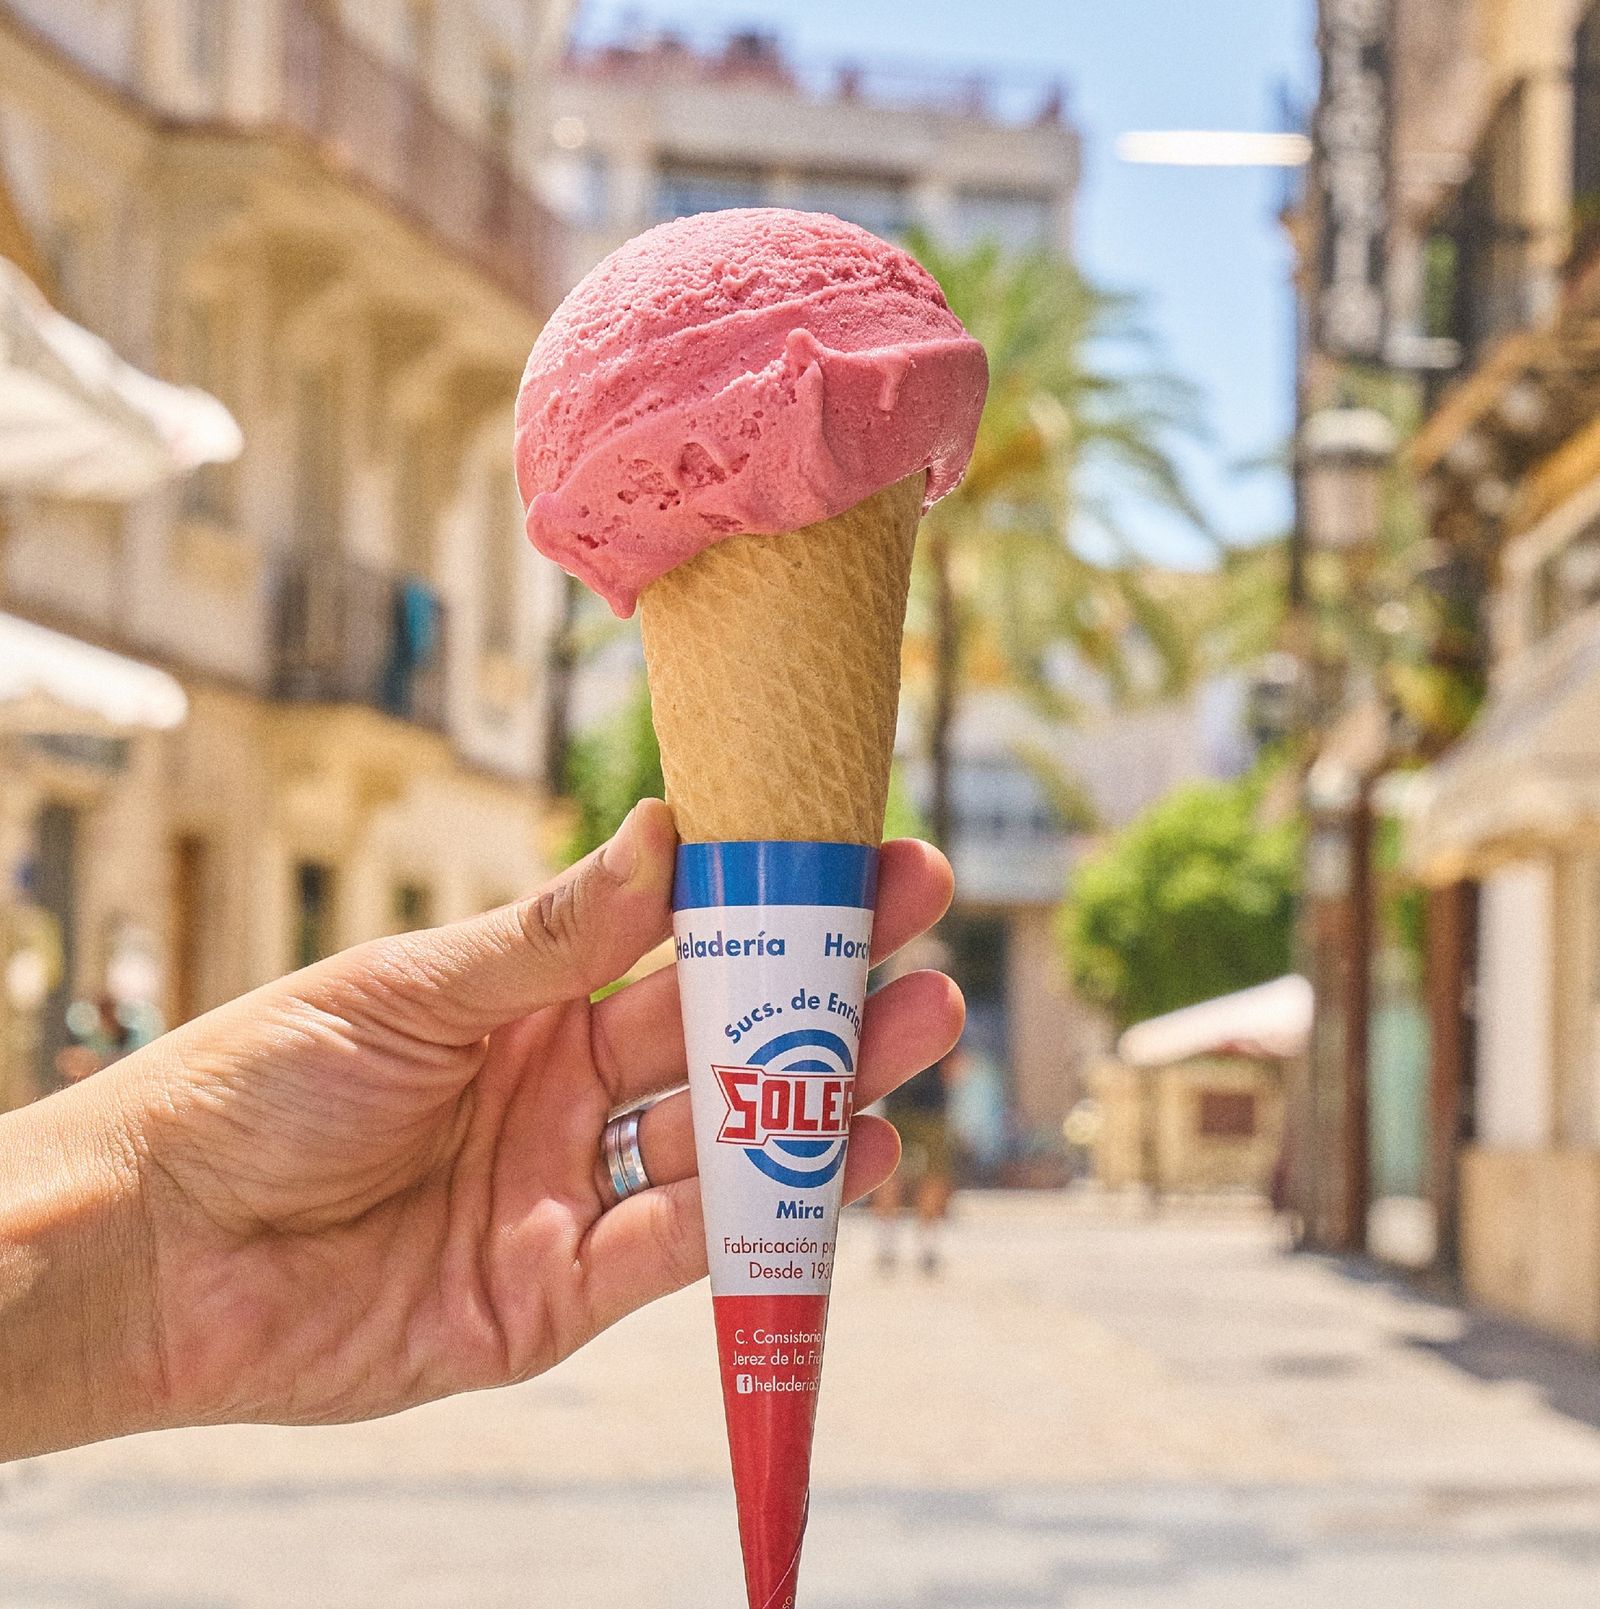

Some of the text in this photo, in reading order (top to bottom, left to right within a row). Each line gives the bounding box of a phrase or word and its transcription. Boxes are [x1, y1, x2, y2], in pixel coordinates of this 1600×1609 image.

[675, 930, 786, 961] Heladería
[724, 1002, 783, 1044] Sucs.
[790, 988, 821, 1011] de
[775, 1200, 824, 1219] Mira
[724, 1235, 818, 1255] Fabricación
[750, 1261, 804, 1280] Desde
[735, 1329, 749, 1345] C.
[733, 1350, 766, 1366] Jerez
[770, 1349, 789, 1365] de
[793, 1348, 805, 1365] la
